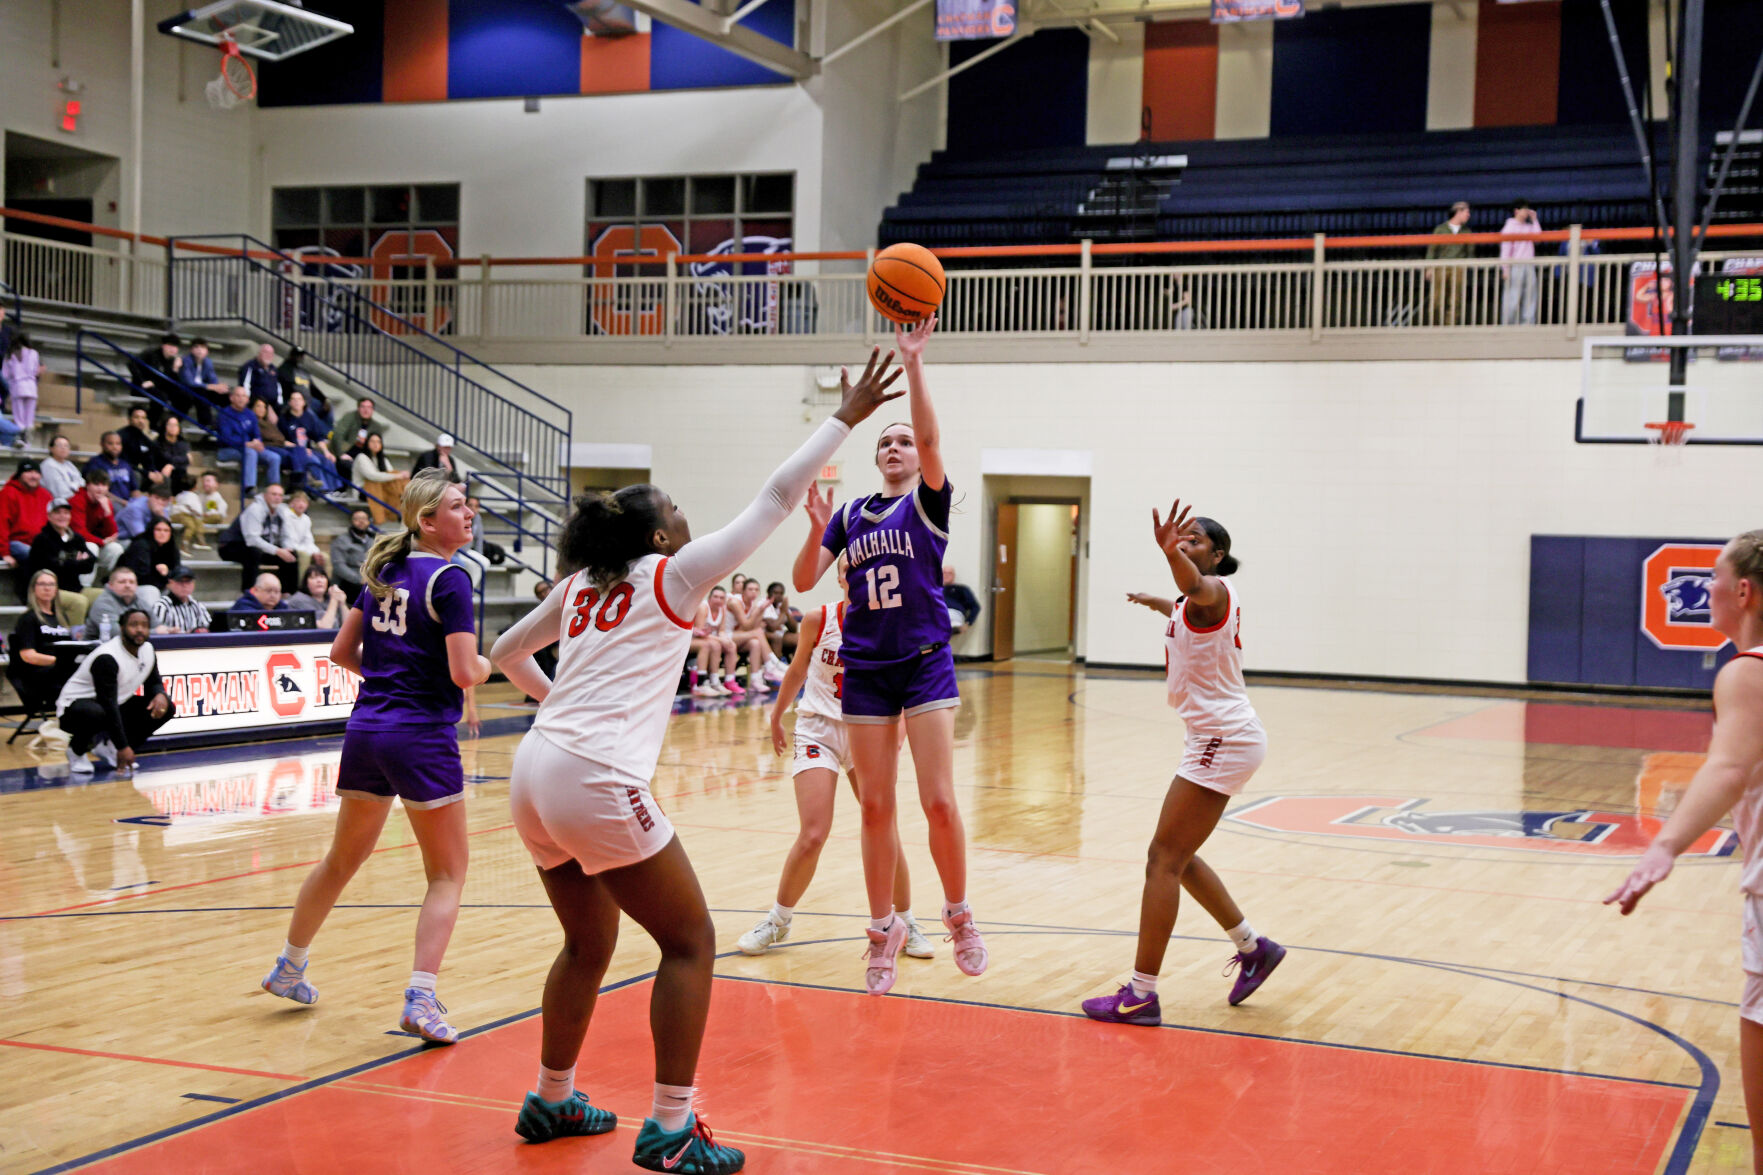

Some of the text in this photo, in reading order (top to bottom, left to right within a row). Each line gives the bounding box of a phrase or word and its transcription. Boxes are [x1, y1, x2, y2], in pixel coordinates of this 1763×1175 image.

[849, 529, 914, 568] WALHALLA
[568, 581, 635, 638] 30
[865, 564, 902, 610] 12
[372, 588, 409, 636] 33
